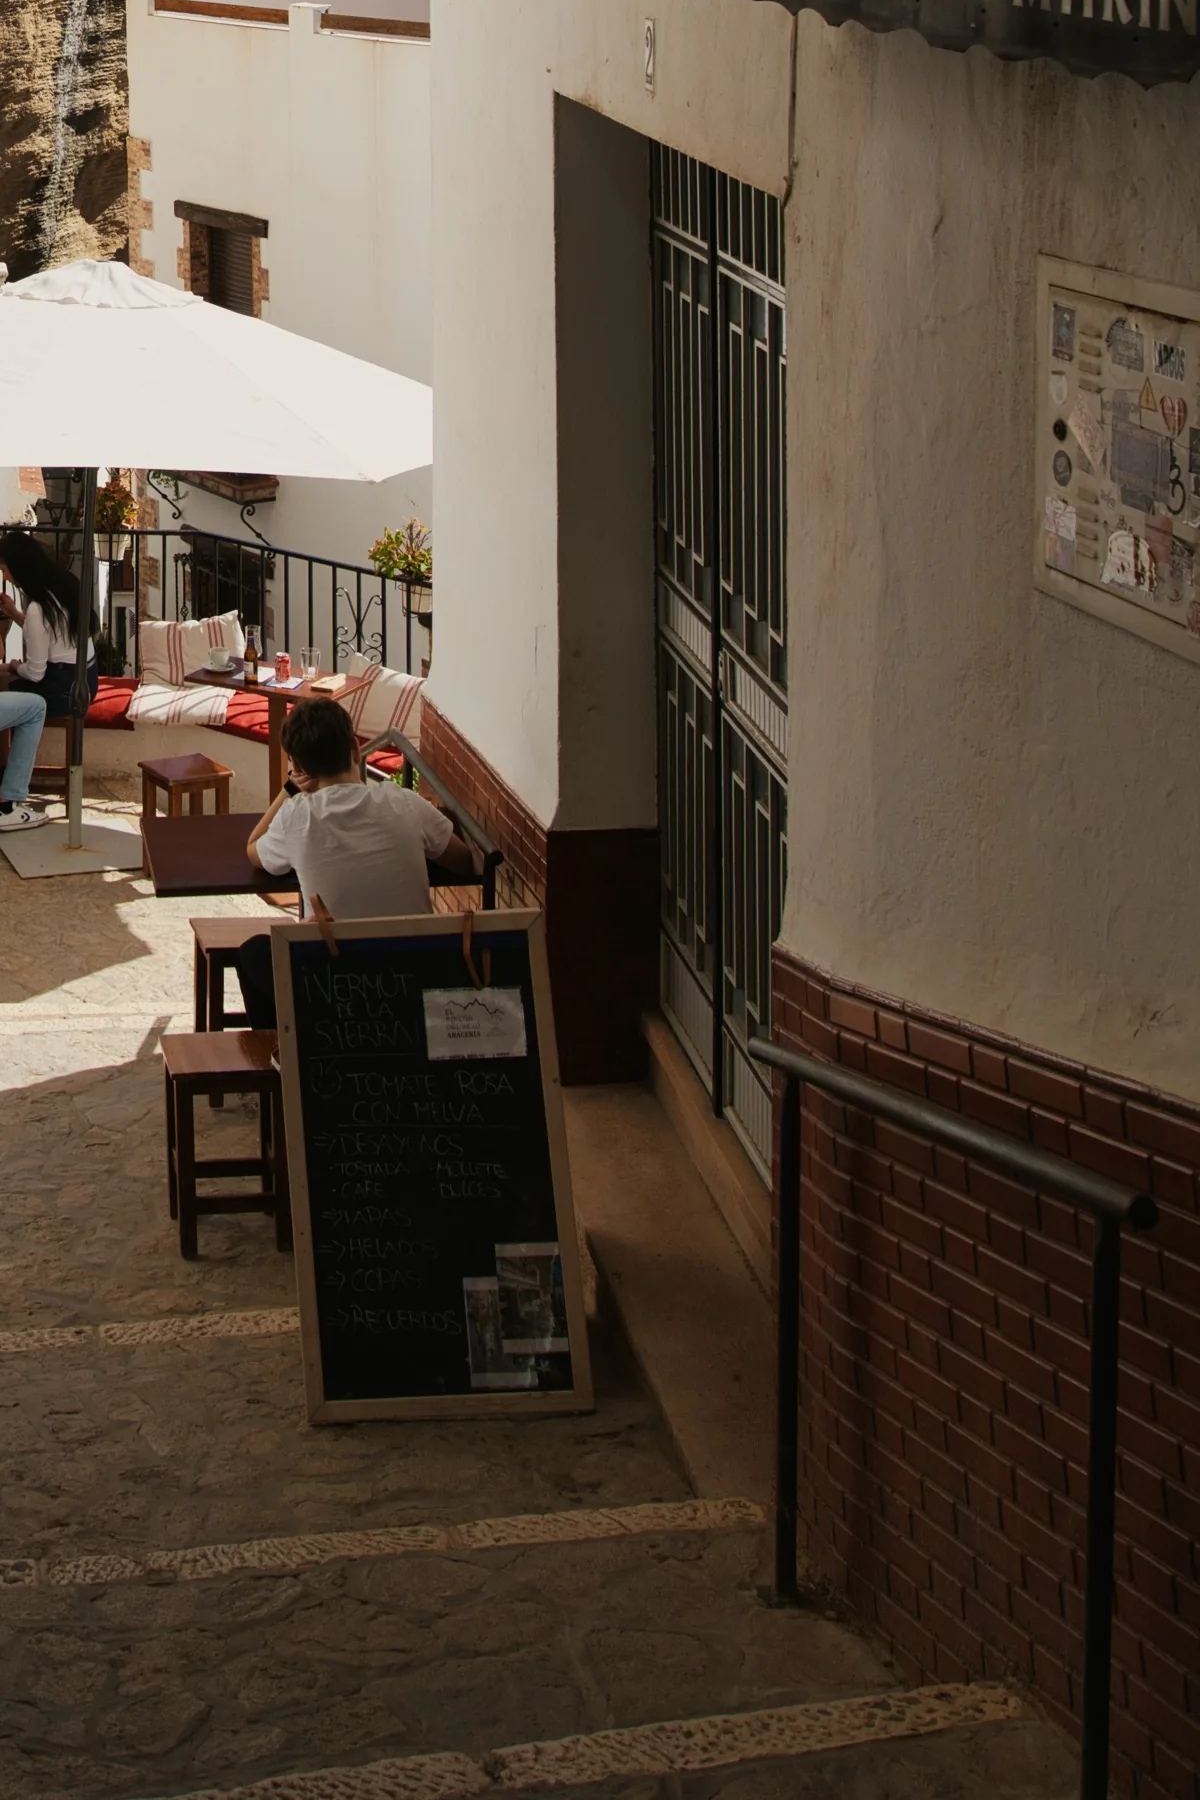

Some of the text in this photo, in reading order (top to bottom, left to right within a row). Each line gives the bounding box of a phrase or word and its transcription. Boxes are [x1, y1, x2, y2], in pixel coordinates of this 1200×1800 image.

[334, 1001, 394, 1018] DE LA
[346, 1069, 516, 1098] TOMATE ROSA
[352, 1100, 485, 1124] CON MELVA
[339, 1131, 465, 1159] DESAYUNOS
[333, 1160, 411, 1179] TOSTADA
[436, 1160, 509, 1180] MOLLETE
[439, 1181, 502, 1199] DULCES
[349, 1236, 441, 1260] HELADOS
[351, 1267, 424, 1293] COPAS
[348, 1302, 464, 1336] RECUERDOS
